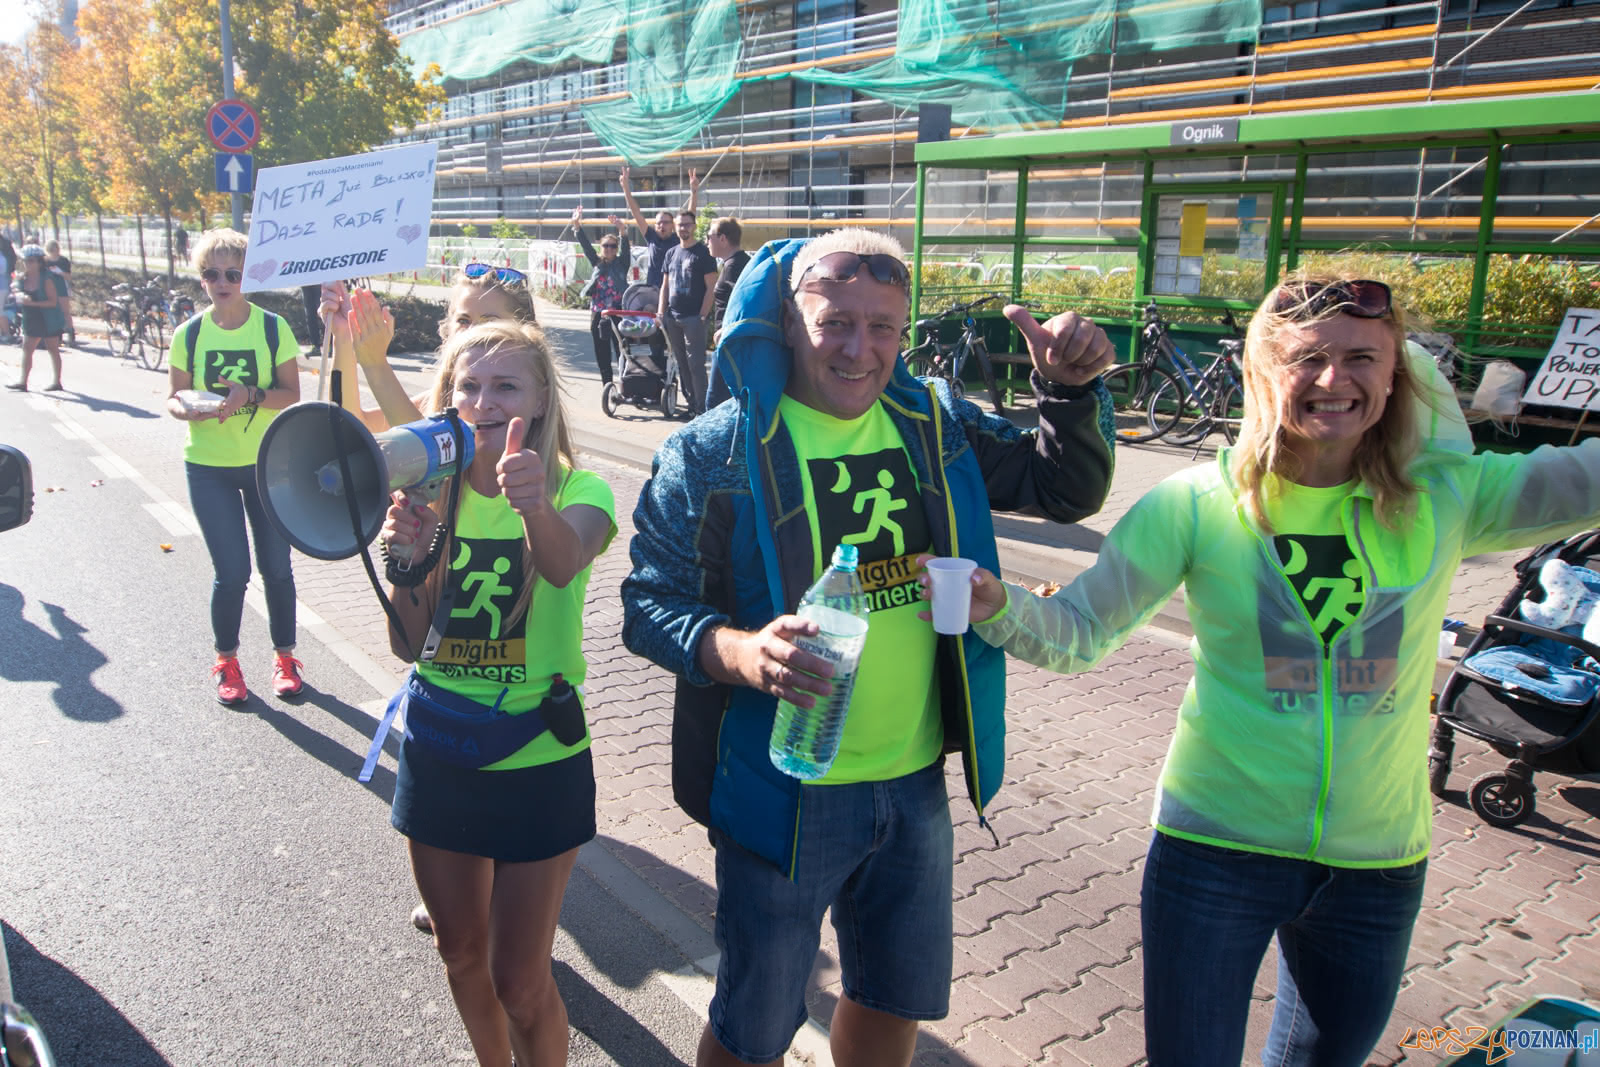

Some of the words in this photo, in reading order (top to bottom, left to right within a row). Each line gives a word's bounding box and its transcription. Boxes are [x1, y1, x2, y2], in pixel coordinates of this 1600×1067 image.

[1182, 124, 1224, 142] Ognik
[257, 180, 325, 214] META
[256, 219, 316, 247] DASZ
[279, 249, 389, 276] BRIDGESTONE
[1565, 342, 1600, 358] TO
[1538, 375, 1600, 408] UP!
[450, 639, 508, 664] night
